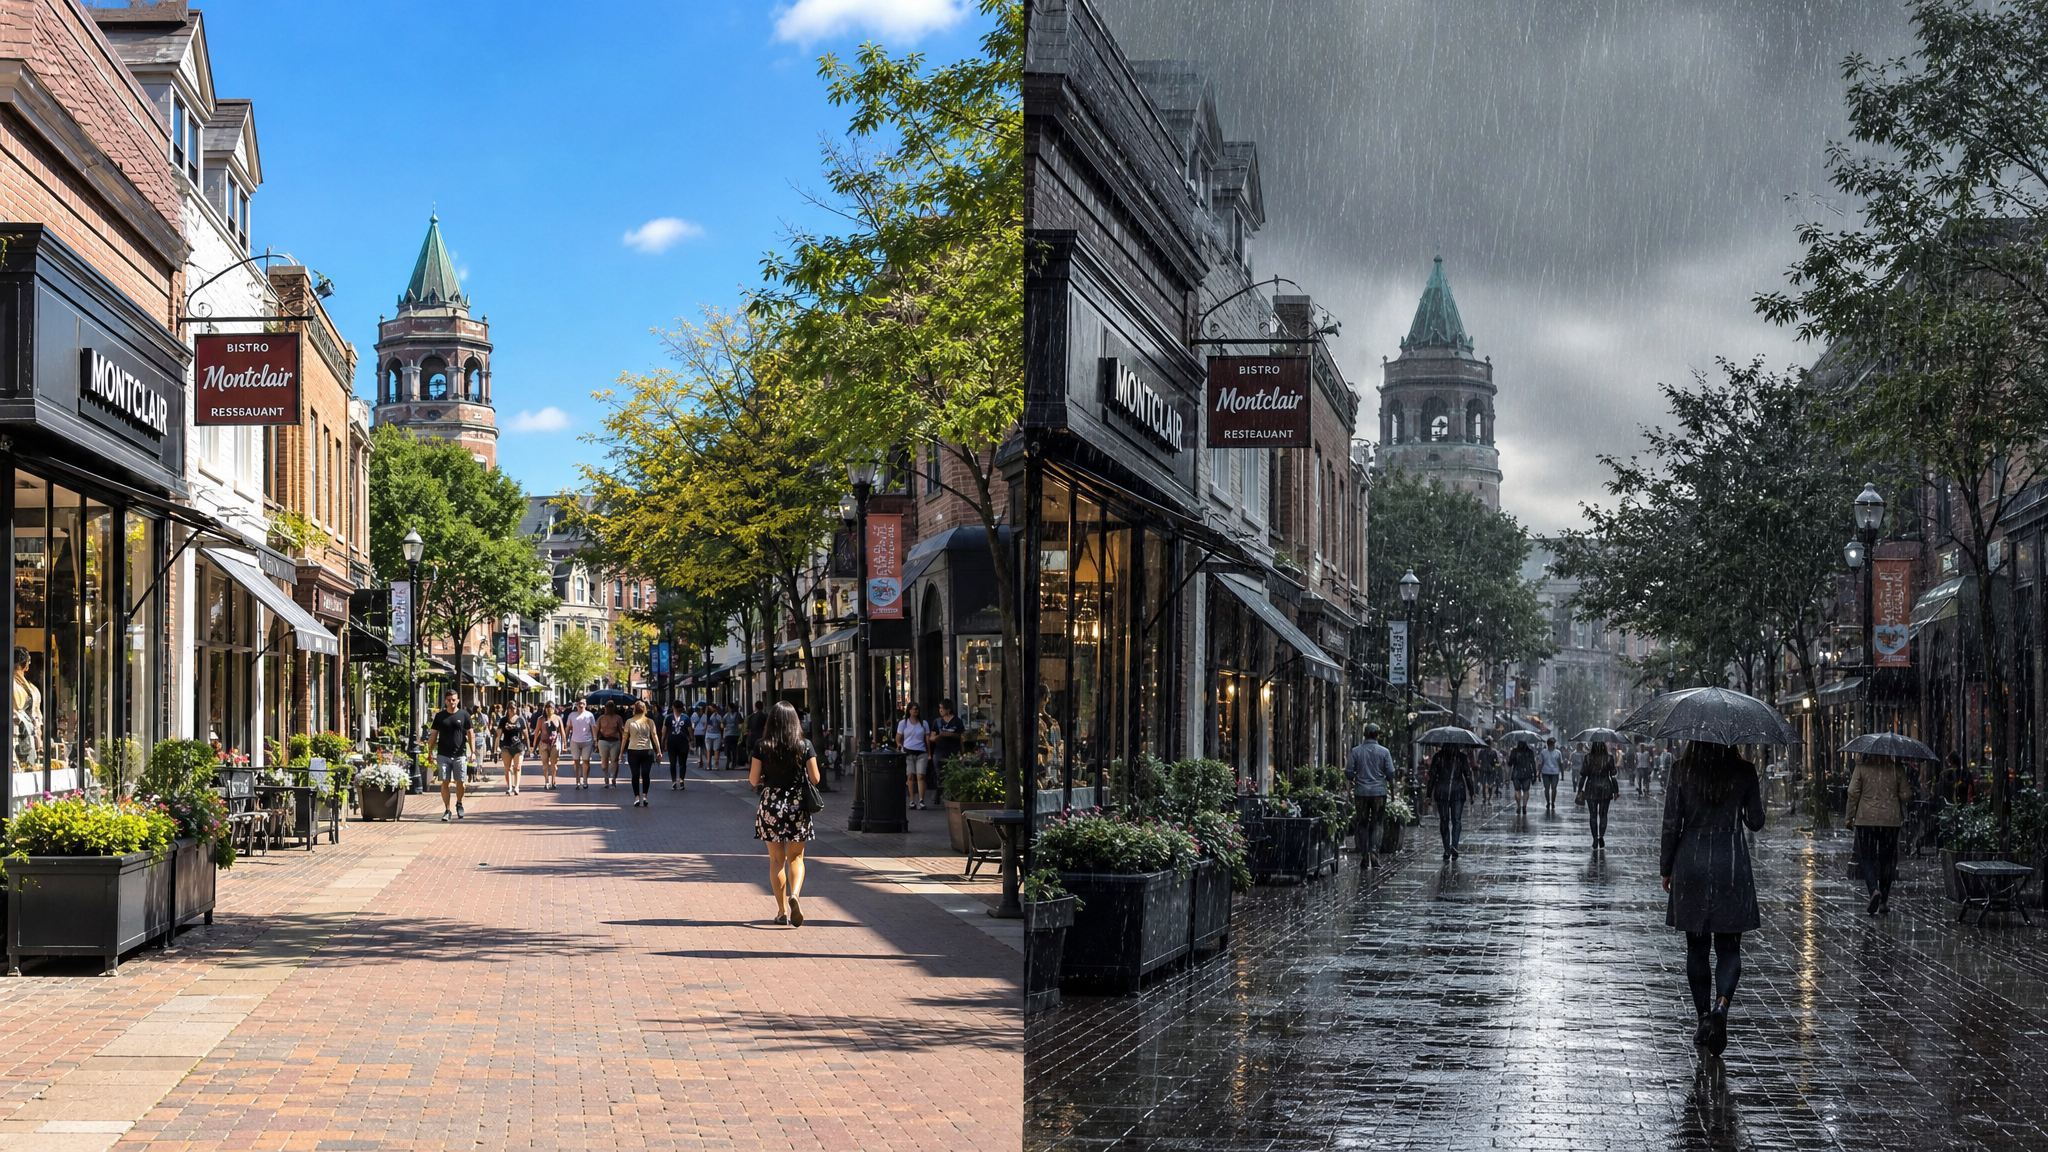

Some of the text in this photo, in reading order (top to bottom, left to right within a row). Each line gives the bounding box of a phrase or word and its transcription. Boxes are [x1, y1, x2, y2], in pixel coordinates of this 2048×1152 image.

[227, 343, 269, 353] BISTRO
[203, 364, 293, 392] Montclair
[1239, 365, 1281, 375] BISTRO
[91, 349, 168, 436] MONTCLAIR
[1115, 358, 1183, 453] MONTCLAIR
[1215, 386, 1304, 414] Montclair
